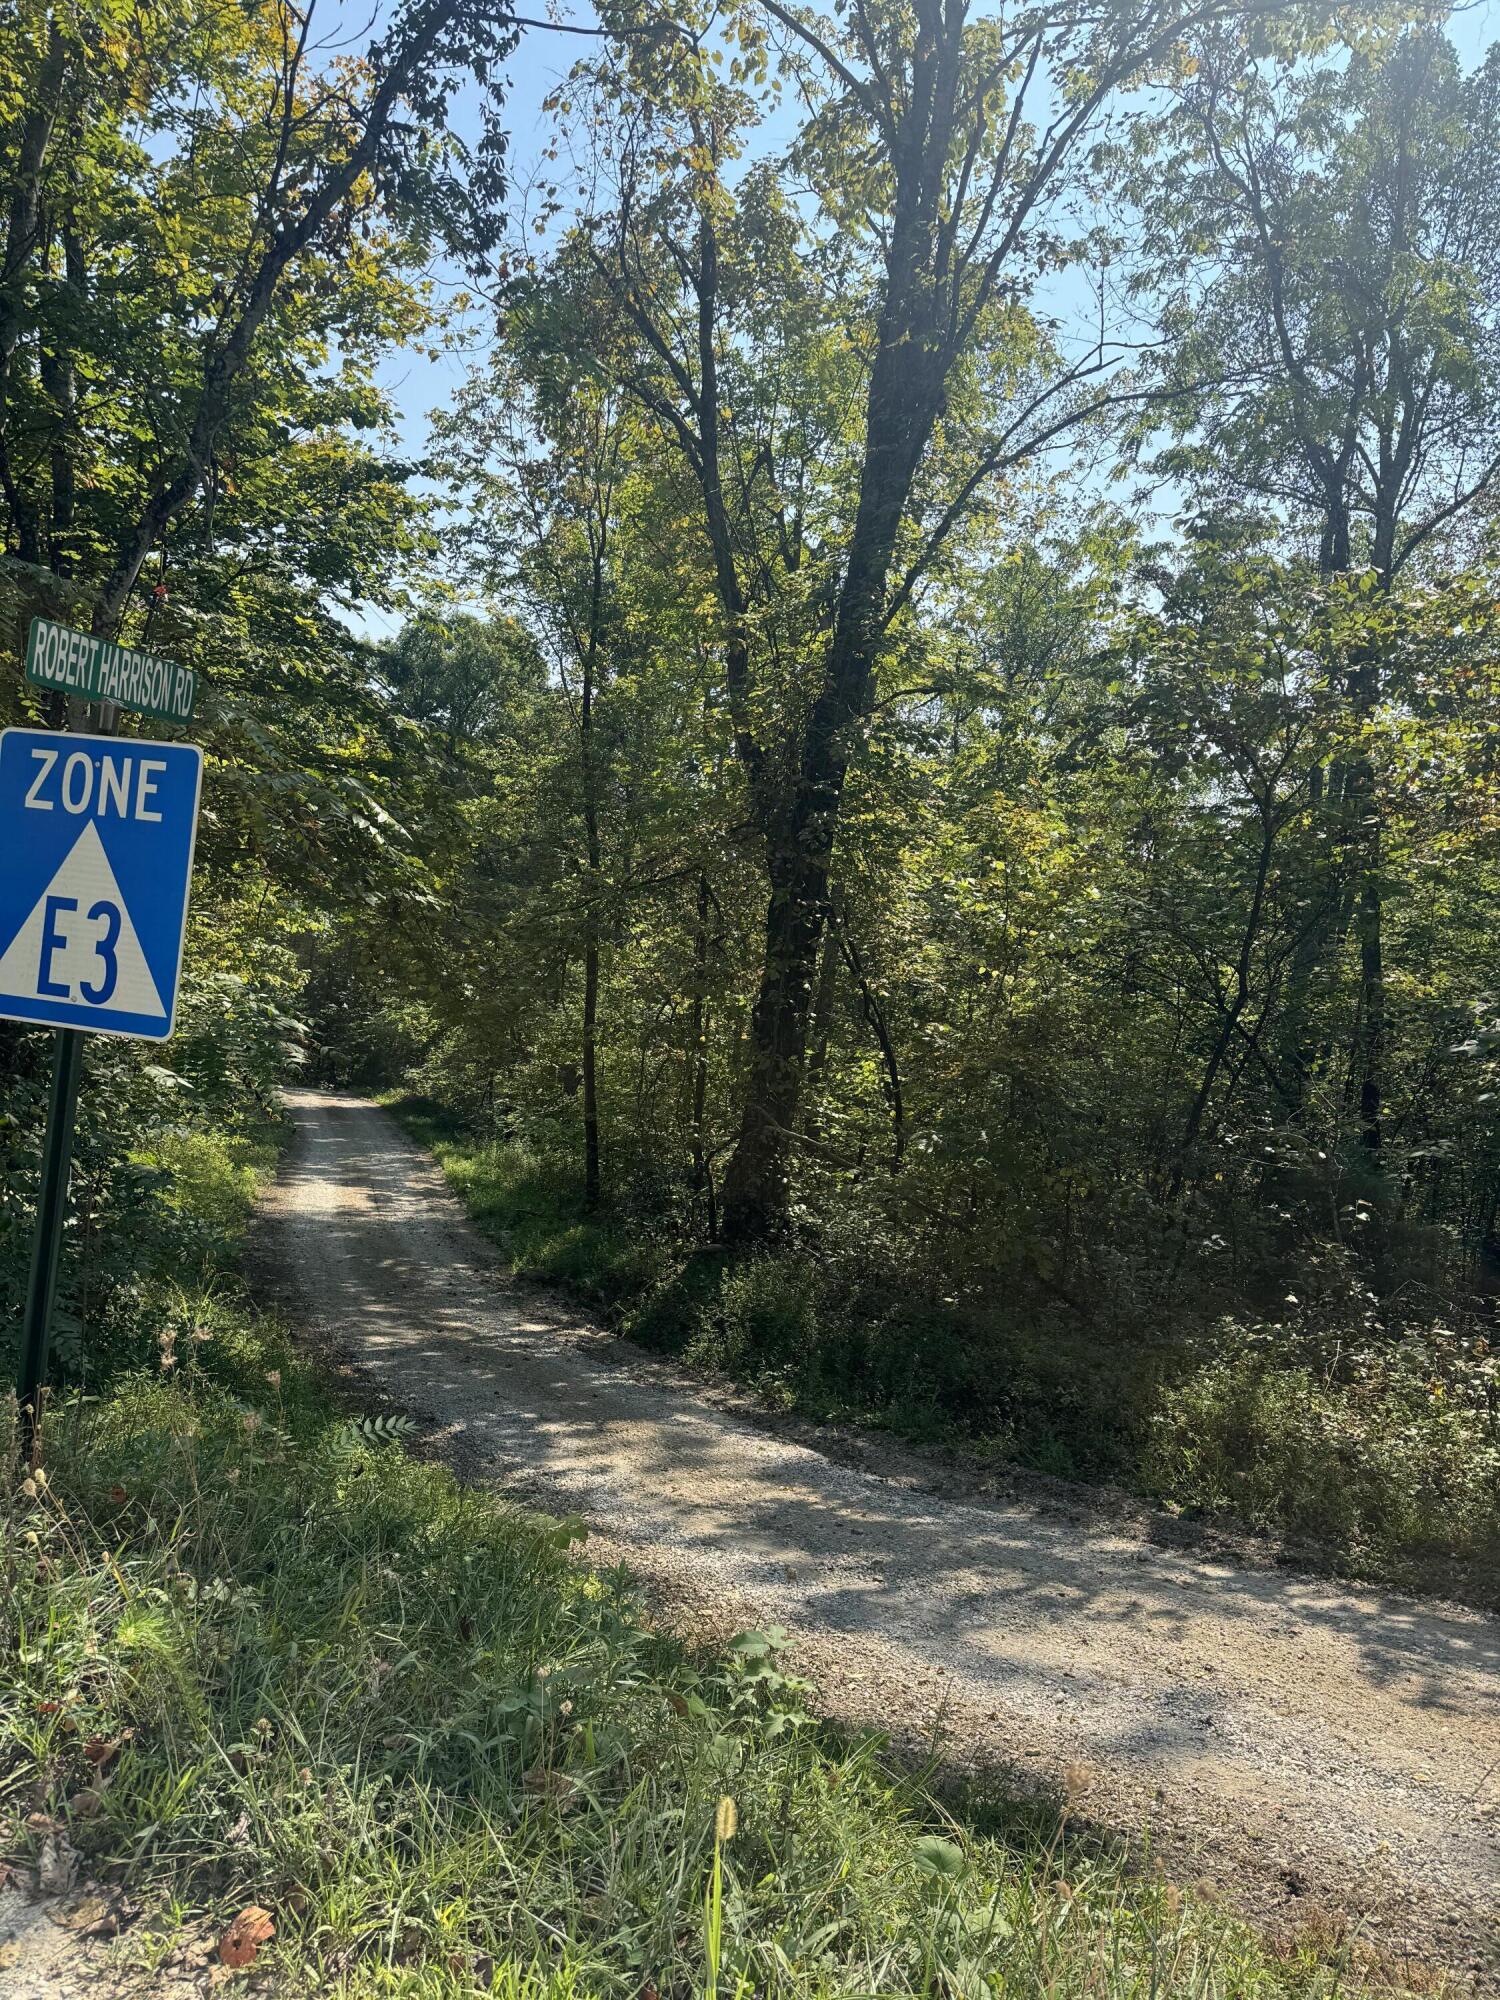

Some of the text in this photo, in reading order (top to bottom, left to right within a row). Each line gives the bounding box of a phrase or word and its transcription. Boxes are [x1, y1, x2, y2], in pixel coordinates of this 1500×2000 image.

[32, 621, 194, 717] ROBERT HARRISON RD
[24, 748, 167, 822] ZONE
[36, 895, 122, 1005] E3
